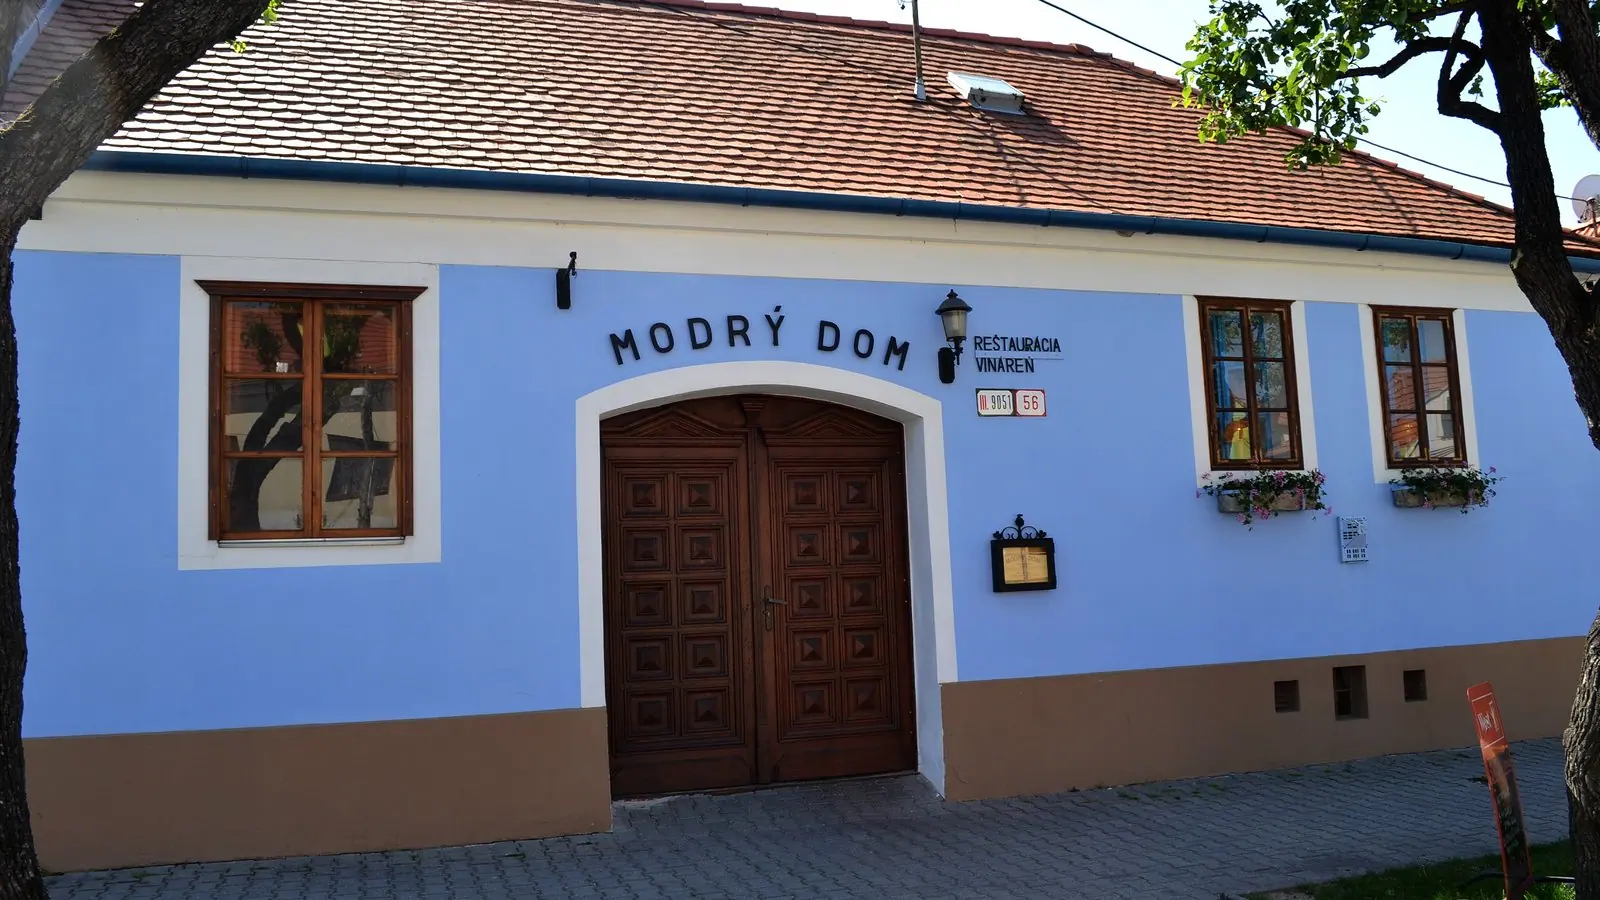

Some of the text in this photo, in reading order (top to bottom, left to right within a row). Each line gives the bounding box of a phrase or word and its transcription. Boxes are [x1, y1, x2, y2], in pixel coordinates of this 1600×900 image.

[609, 305, 910, 371] MODRÝ DOM
[973, 334, 1061, 353] REŠTAURÁCIA
[975, 356, 1035, 373] VINÁREŇ
[991, 395, 1012, 410] 9051
[1023, 395, 1039, 410] 56
